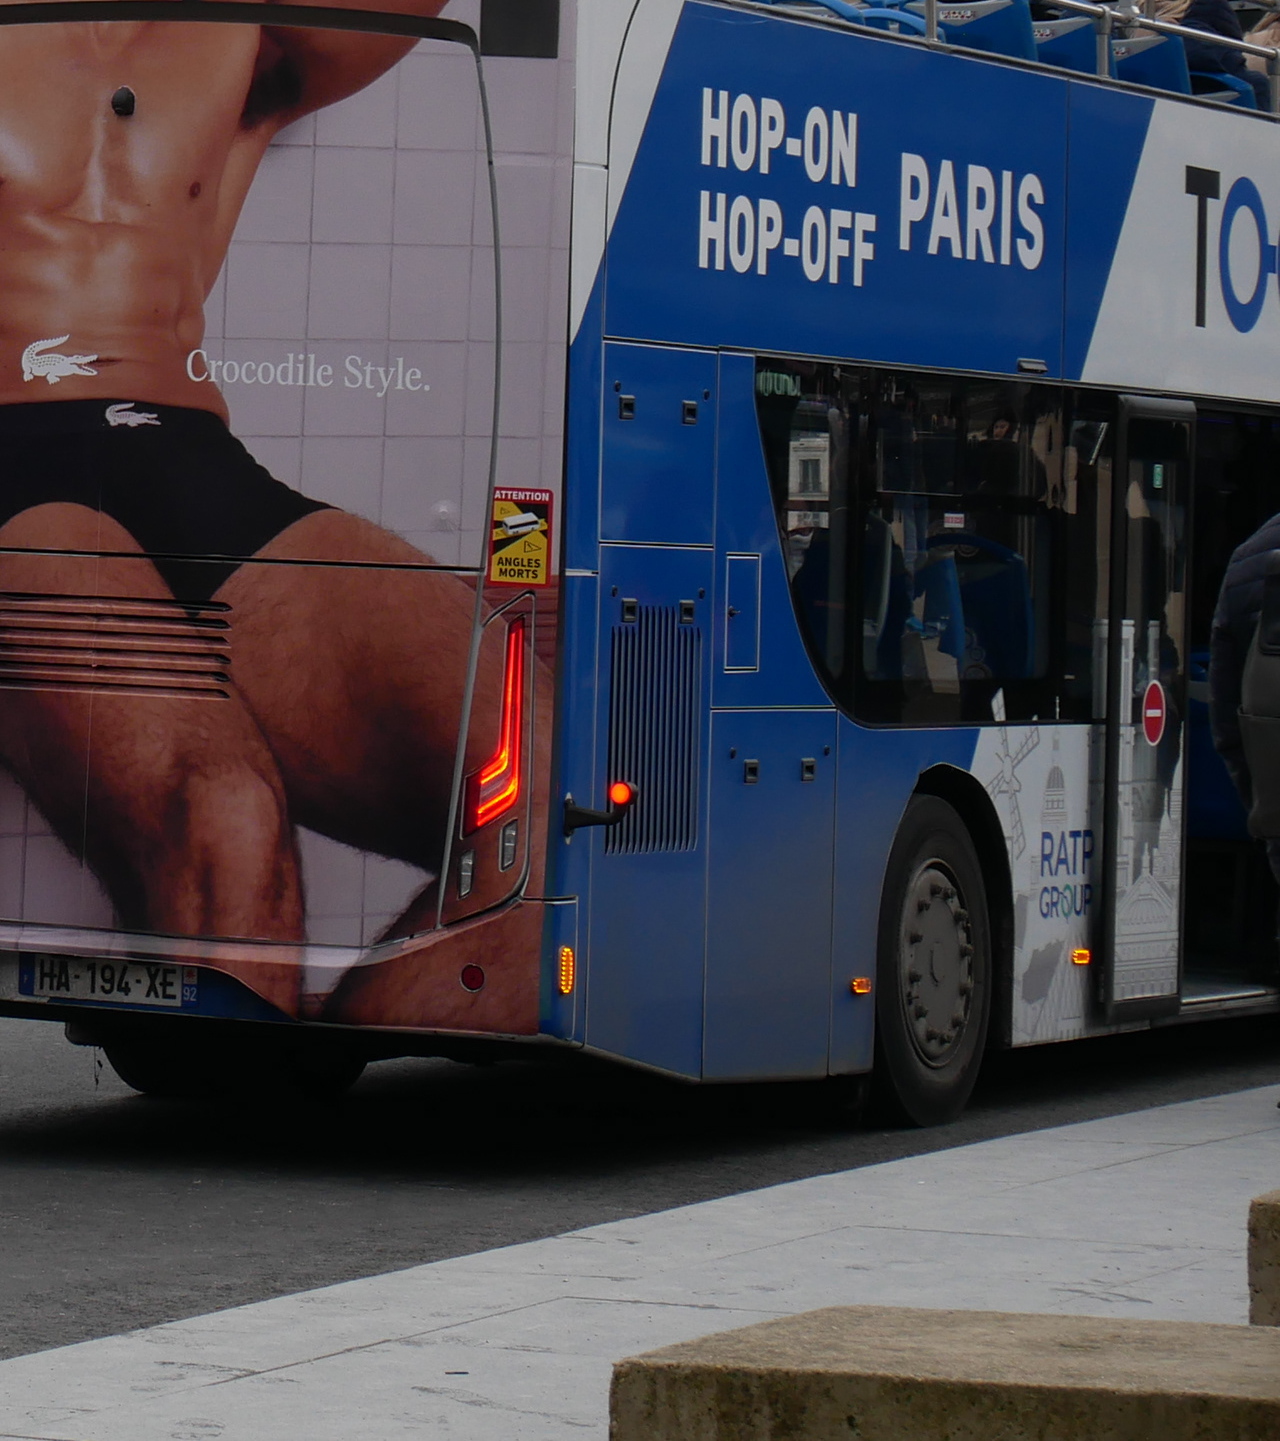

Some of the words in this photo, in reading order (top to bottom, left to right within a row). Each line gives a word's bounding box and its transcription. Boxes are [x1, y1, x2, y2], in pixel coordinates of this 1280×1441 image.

[701, 87, 858, 187] HOP-ON
[899, 152, 1045, 270] PARIS
[698, 190, 877, 287] HOP-OFF
[186, 349, 334, 387] Crocodile
[344, 355, 431, 398] Style.
[494, 490, 550, 501] ATTENTION
[497, 557, 541, 568] ANGLES
[499, 568, 539, 579] MORTS
[1041, 829, 1095, 877] RATP
[1040, 883, 1094, 920] GROUP
[183, 986, 198, 1002] 92
